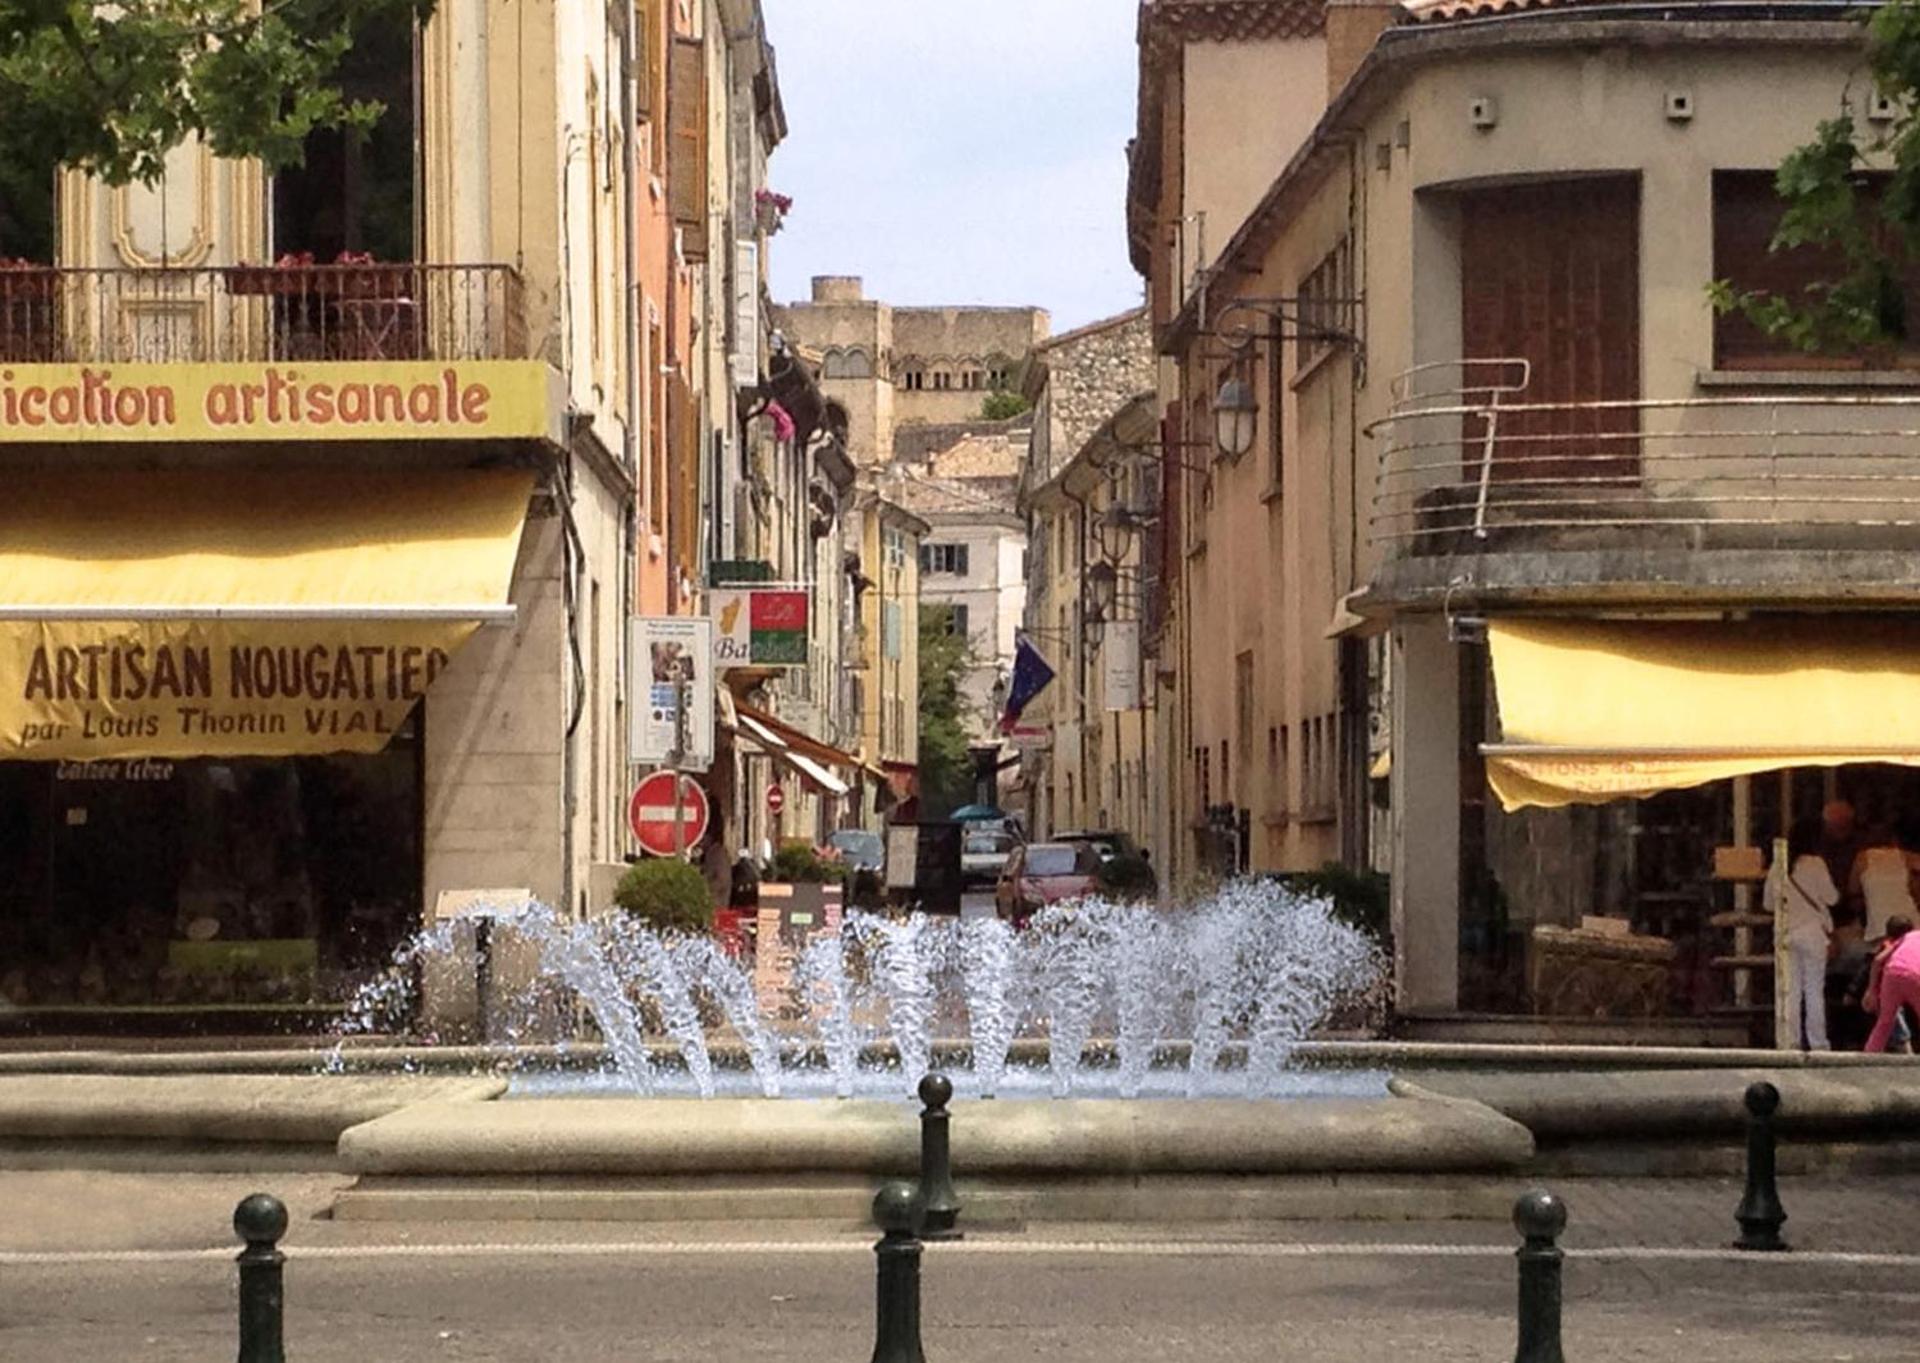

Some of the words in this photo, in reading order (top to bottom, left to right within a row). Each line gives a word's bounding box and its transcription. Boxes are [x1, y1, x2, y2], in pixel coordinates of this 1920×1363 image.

[3, 367, 176, 426] ication
[206, 368, 491, 426] artisanale
[24, 642, 212, 701] ARTISAN
[20, 721, 70, 749] par
[82, 710, 159, 739] Louis
[178, 706, 286, 736] Thonin
[304, 706, 392, 736] VIAL
